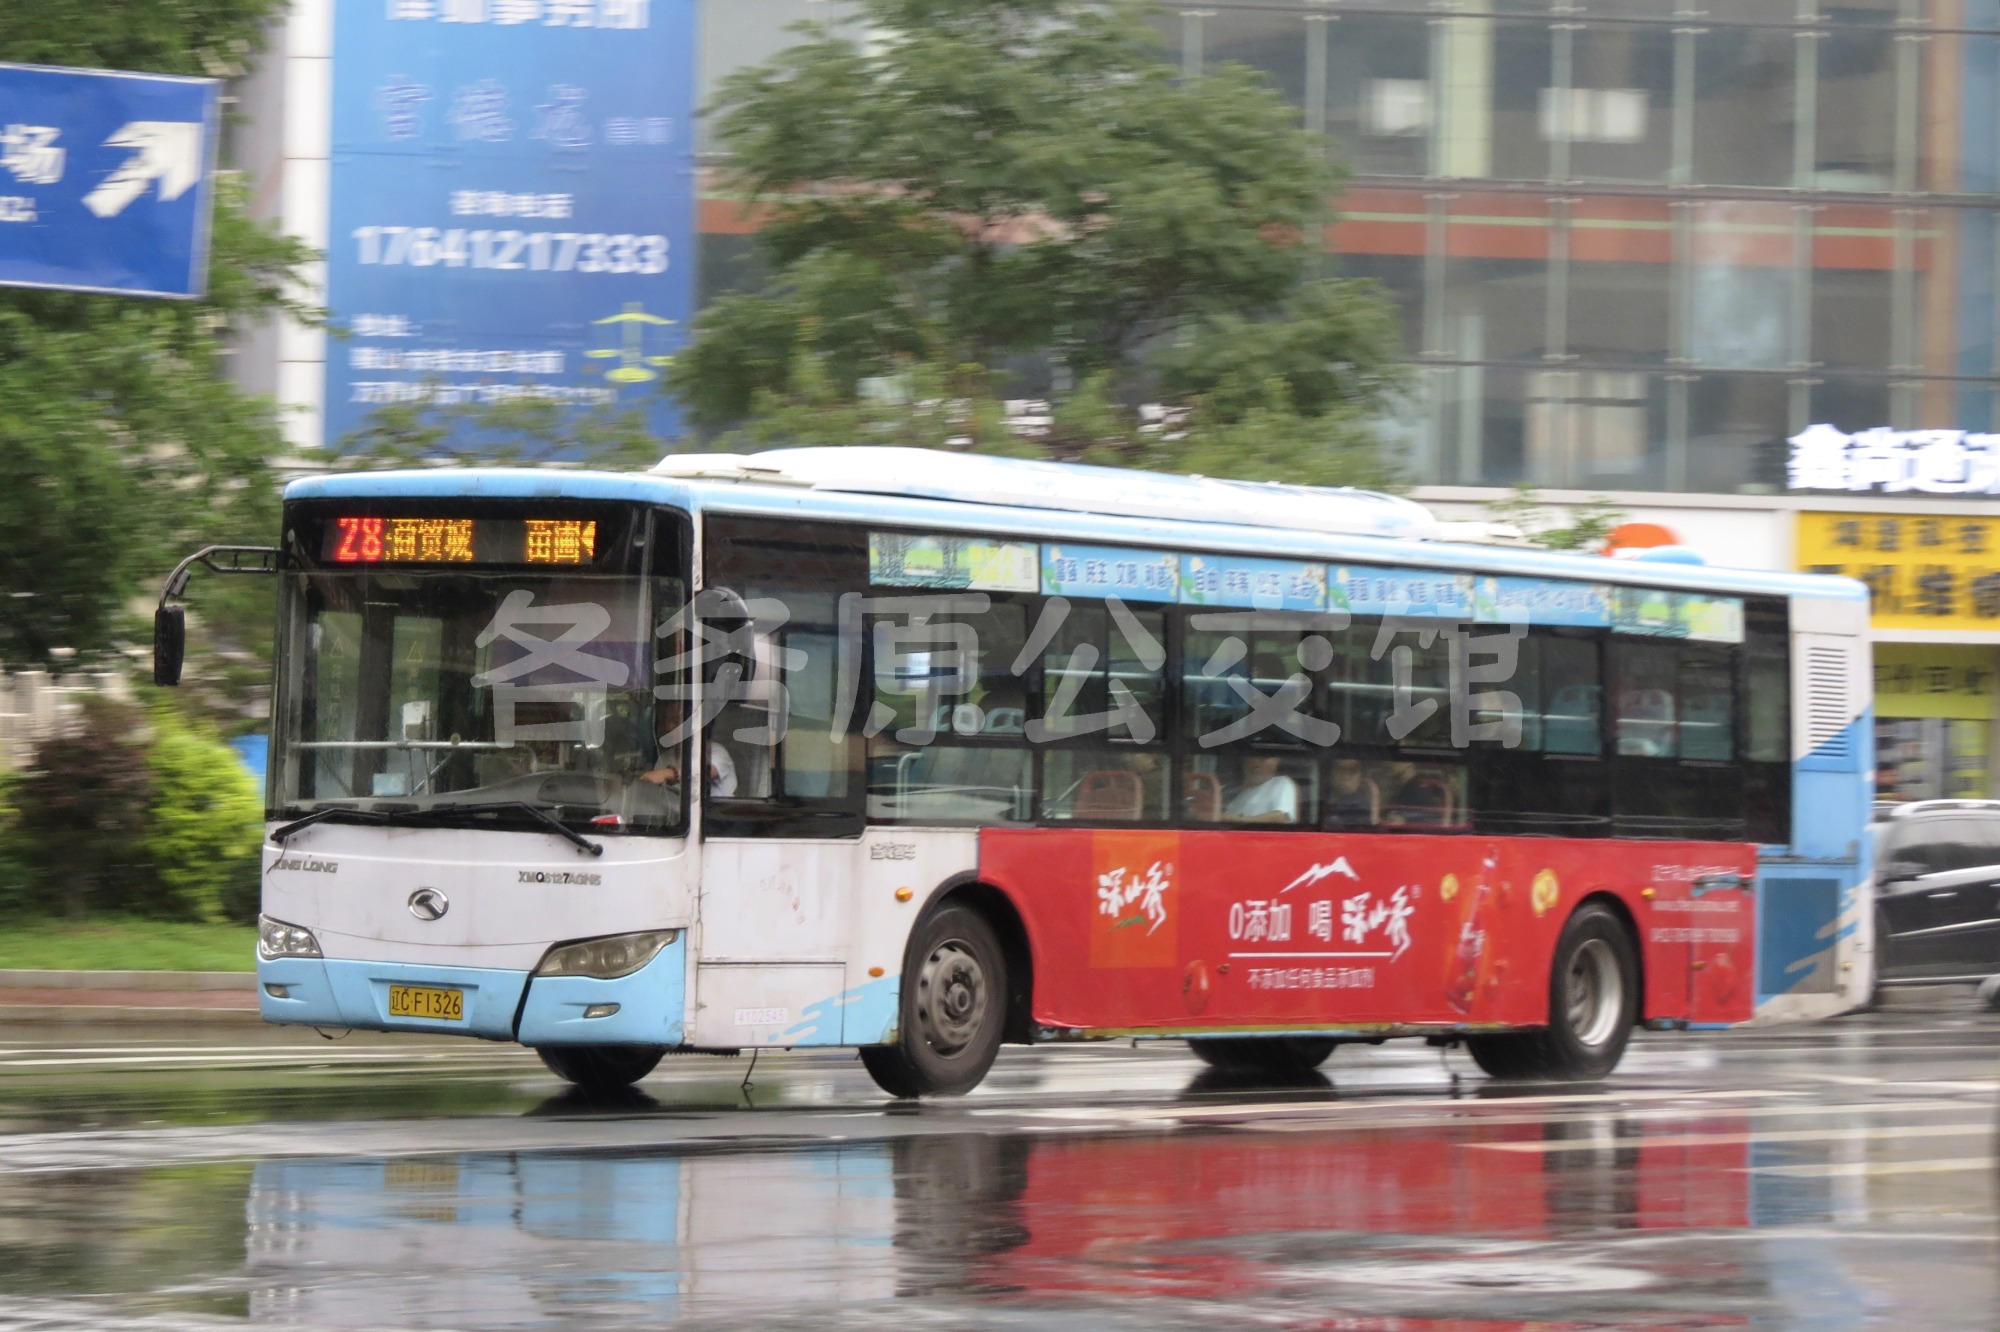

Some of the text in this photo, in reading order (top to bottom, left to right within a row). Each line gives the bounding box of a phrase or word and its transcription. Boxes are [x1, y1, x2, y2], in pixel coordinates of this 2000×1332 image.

[353, 225, 670, 275] 17641217333
[337, 517, 383, 561] 28
[273, 859, 338, 874] KING LONG
[1308, 899, 1333, 942] 喝
